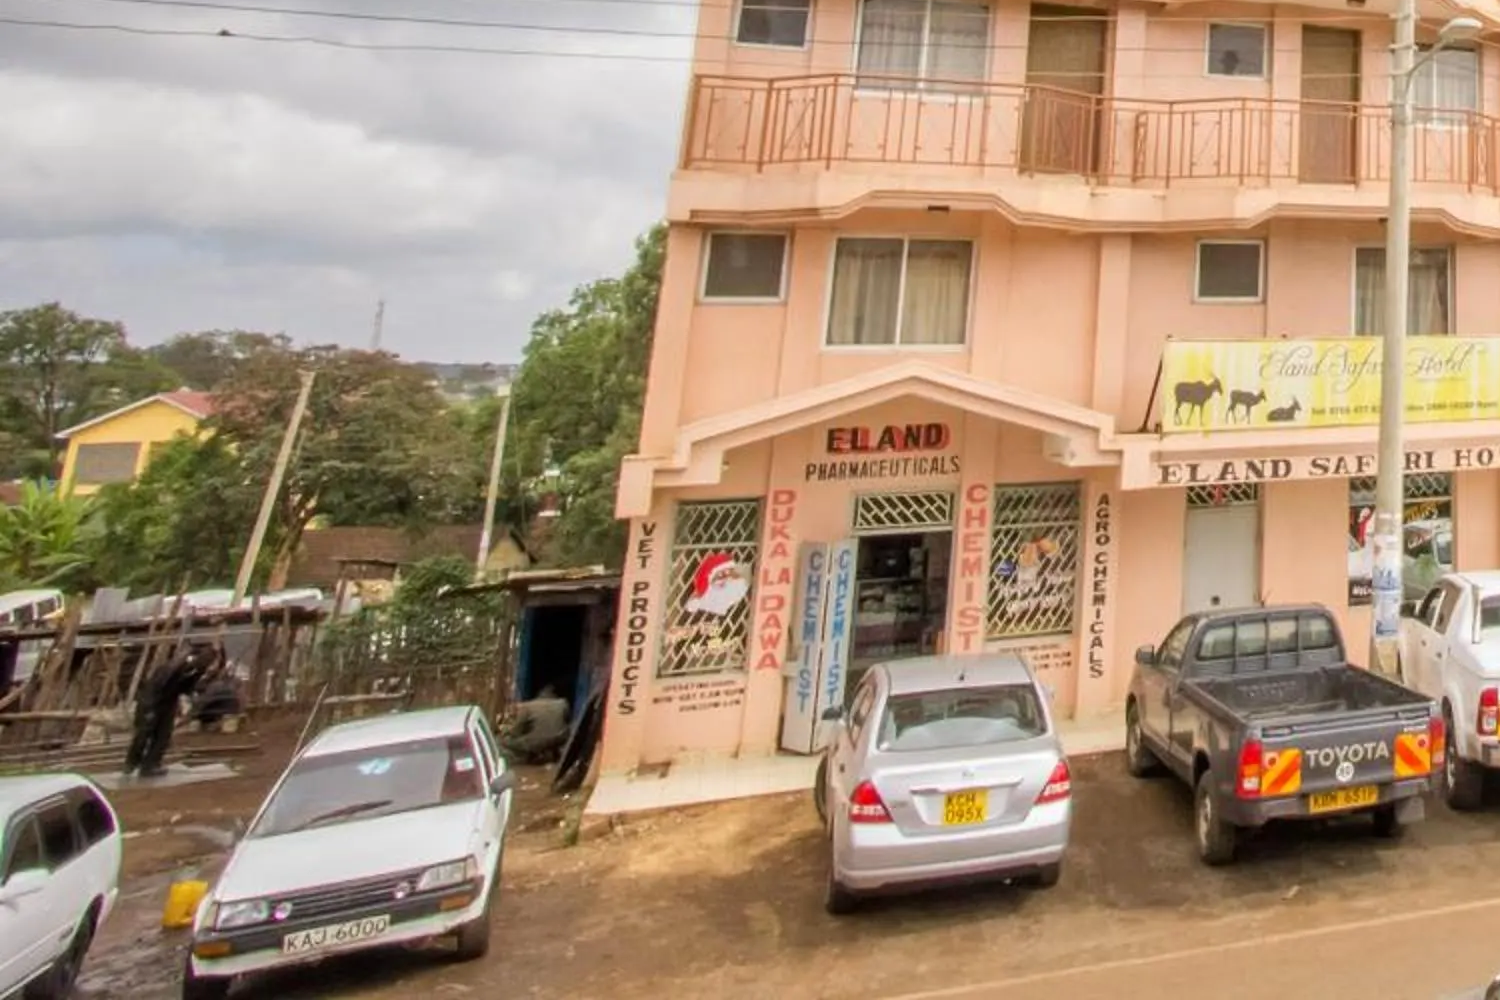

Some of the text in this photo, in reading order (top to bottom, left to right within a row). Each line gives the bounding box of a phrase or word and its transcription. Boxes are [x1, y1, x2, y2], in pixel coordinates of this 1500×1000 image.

[805, 455, 960, 481] PHARMACEUTICALS
[826, 422, 951, 454] ELAND
[1157, 458, 1293, 485] ELAND
[1308, 450, 1435, 476] SAFRI
[756, 489, 797, 670] DUKA LA DAWA
[956, 485, 989, 651] CHEMIST
[1089, 492, 1111, 680] AGRO CHEMICALS
[618, 522, 656, 716] VET PRODUCTS
[797, 551, 824, 713] CHEMIST
[827, 549, 852, 706] CHEMIST
[945, 790, 976, 807] KCH
[1306, 740, 1389, 769] TOYOTA
[944, 806, 984, 824] 095X
